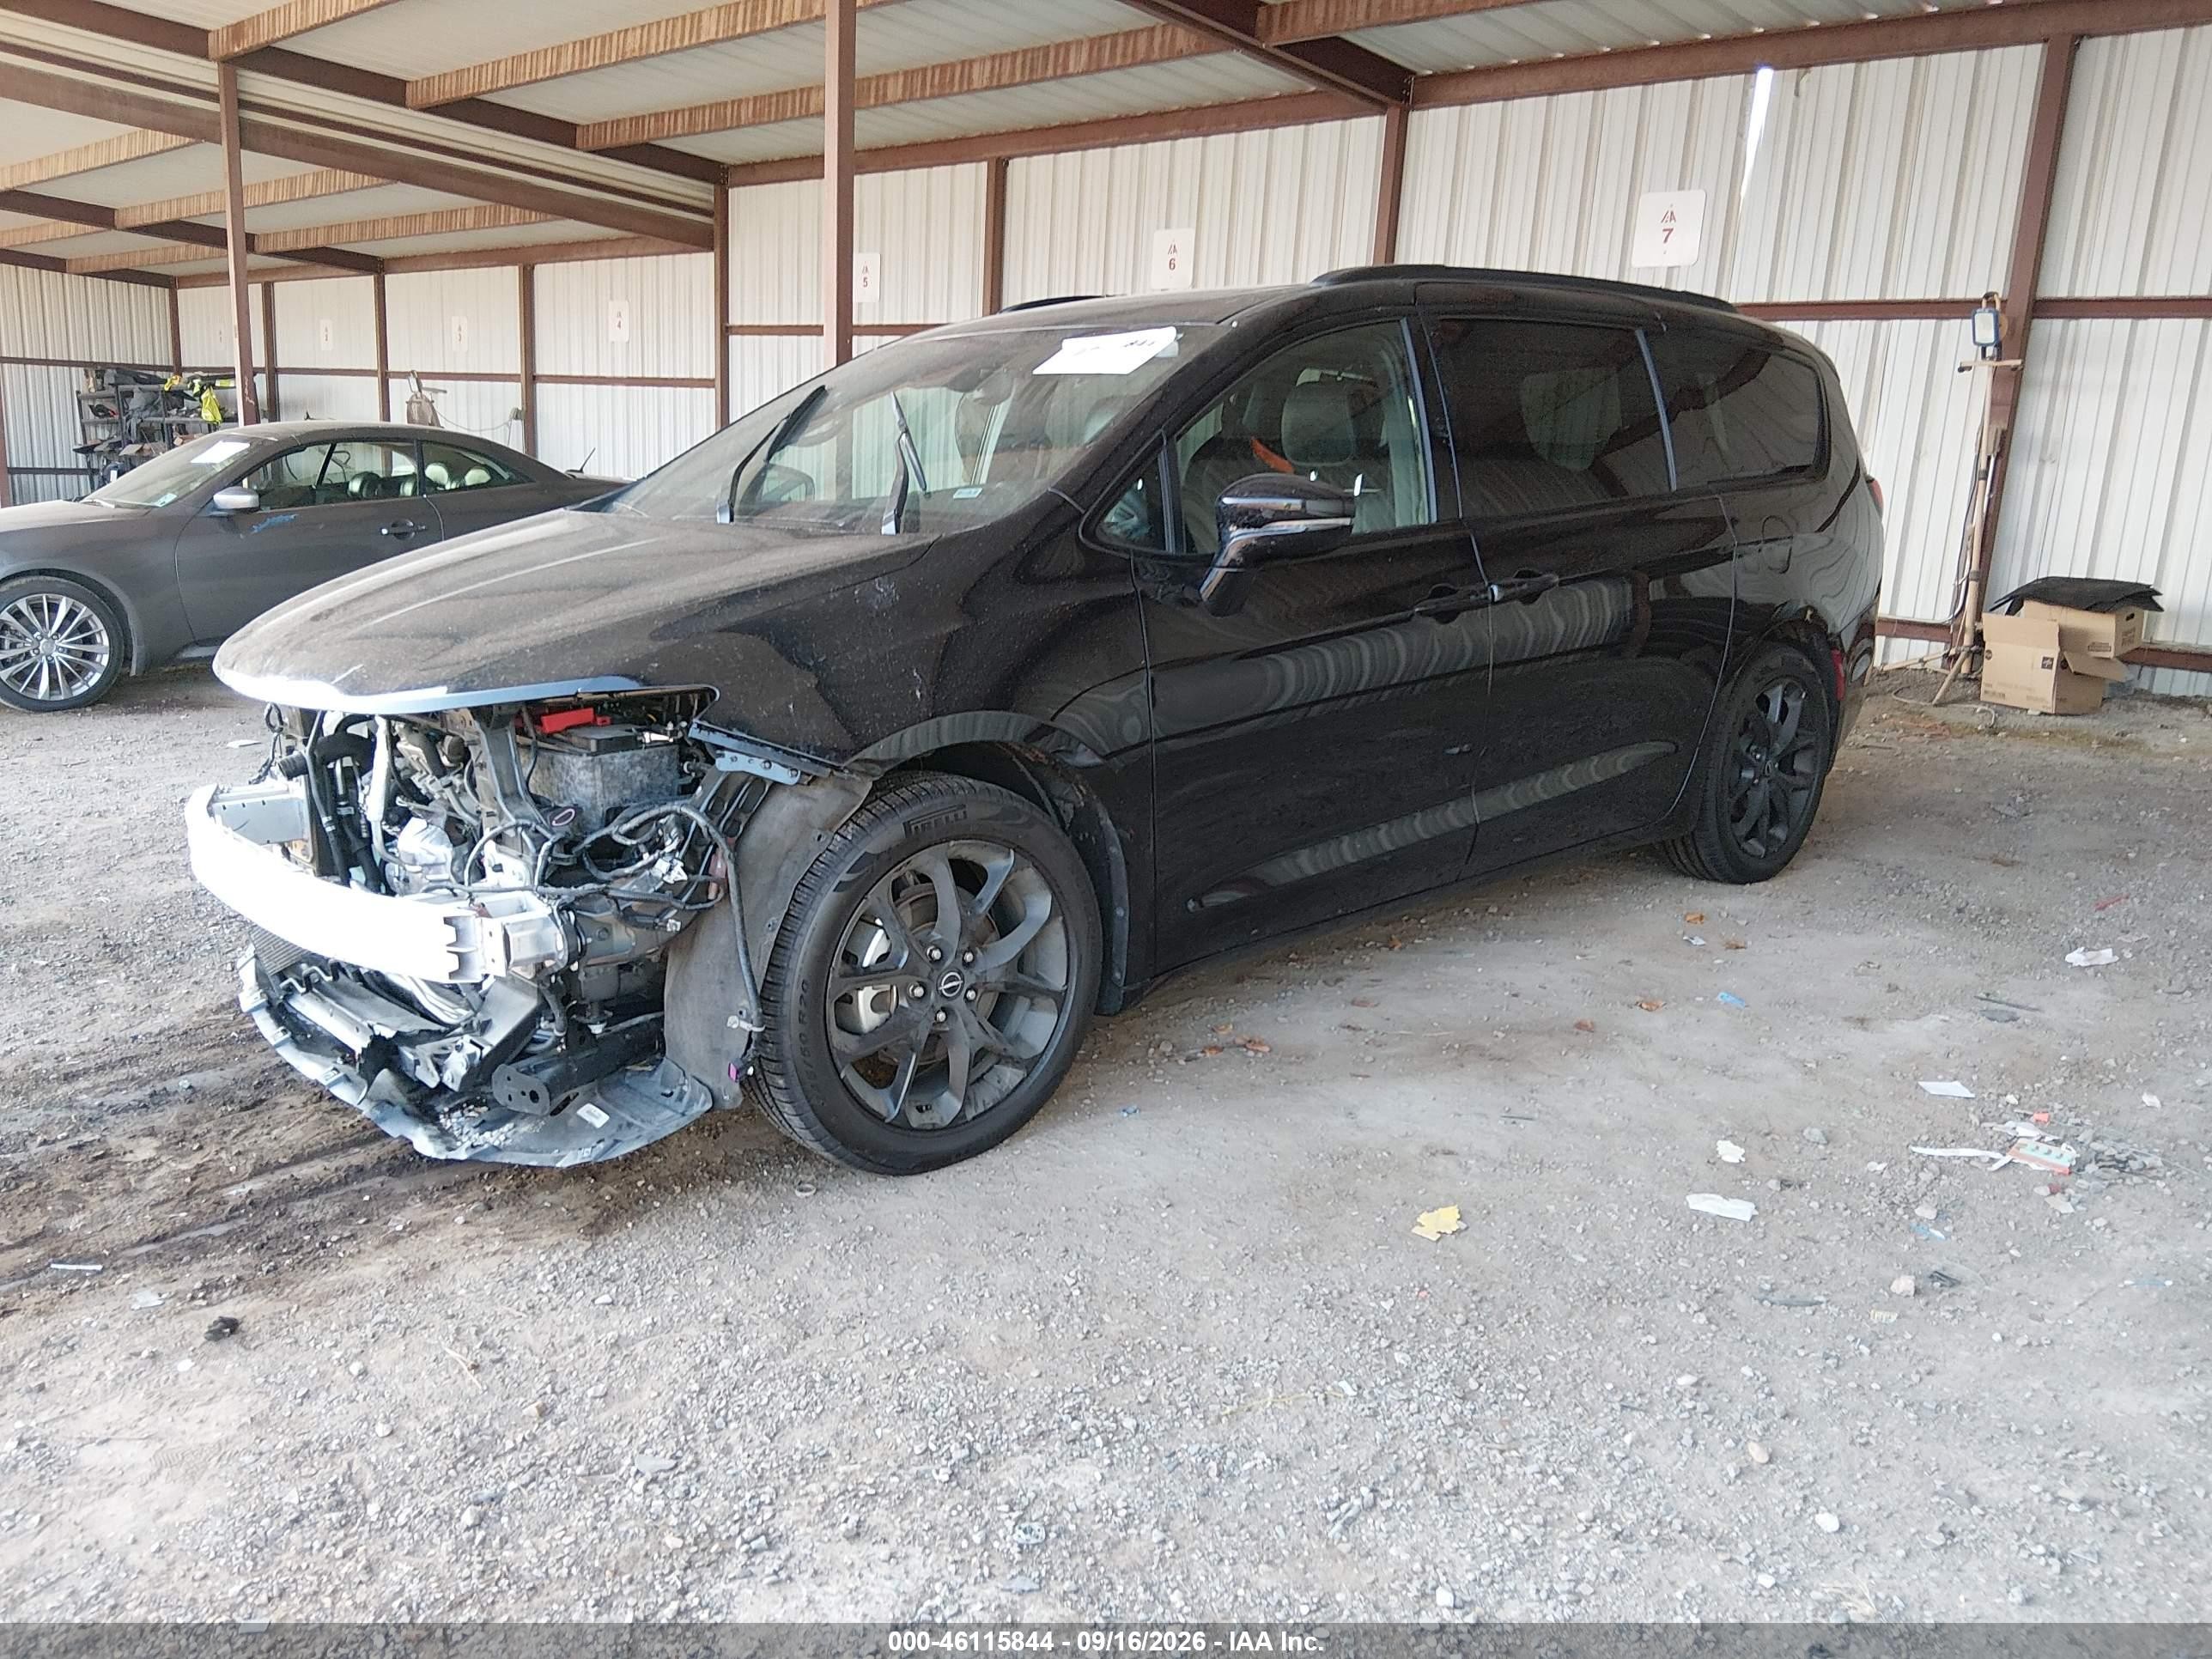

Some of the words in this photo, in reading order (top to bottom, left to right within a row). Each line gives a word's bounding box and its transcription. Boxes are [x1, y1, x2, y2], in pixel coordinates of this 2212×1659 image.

[1662, 228, 1674, 244] 7
[1169, 258, 1176, 271] 6
[863, 276, 868, 289] 5
